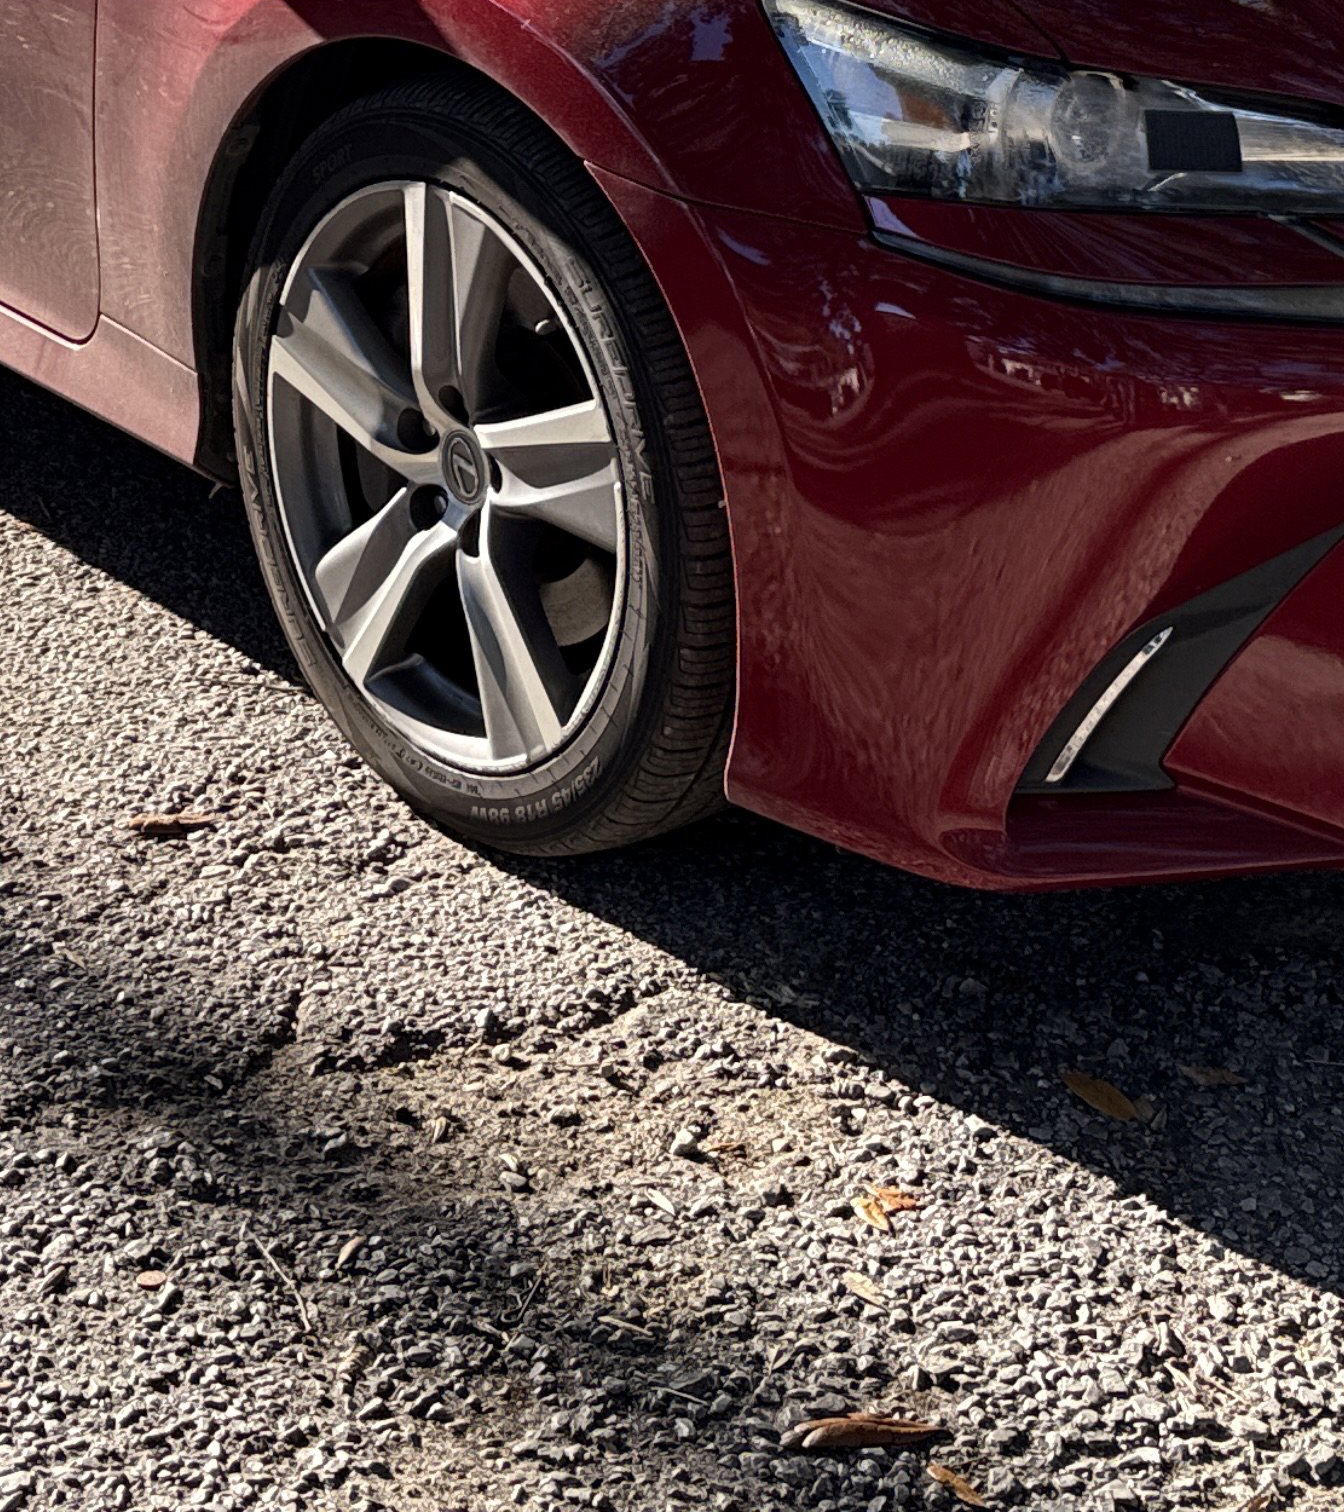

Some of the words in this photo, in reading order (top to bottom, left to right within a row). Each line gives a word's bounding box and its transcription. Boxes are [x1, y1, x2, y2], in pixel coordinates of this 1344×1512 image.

[551, 756, 602, 811] 235/45
[469, 805, 510, 825] 98W
[514, 798, 549, 823] R18
